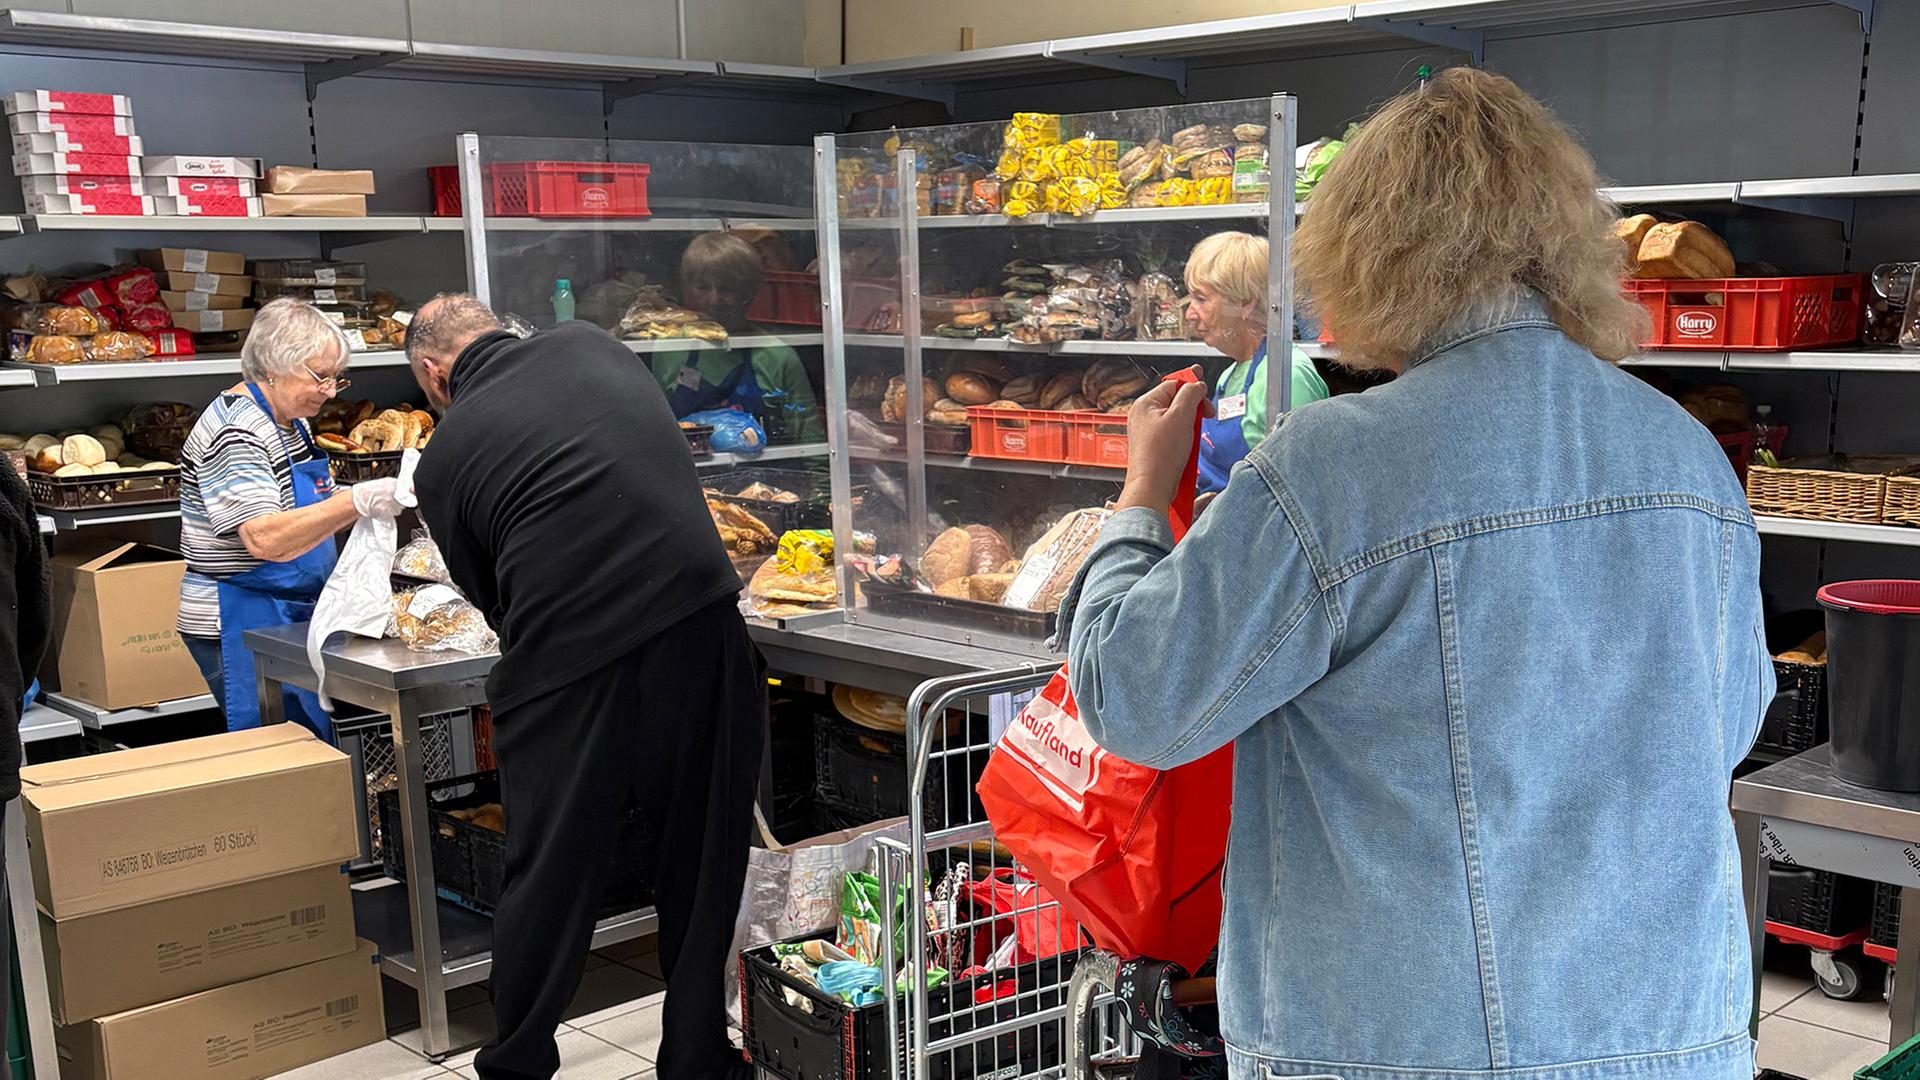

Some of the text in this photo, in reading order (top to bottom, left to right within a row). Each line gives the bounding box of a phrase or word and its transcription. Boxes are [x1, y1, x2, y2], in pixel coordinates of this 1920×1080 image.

[1680, 315, 1713, 330] Harry
[102, 861, 114, 878] AS
[214, 835, 226, 853] 60
[228, 832, 257, 850] Stück
[1766, 831, 1786, 855] Fiber
